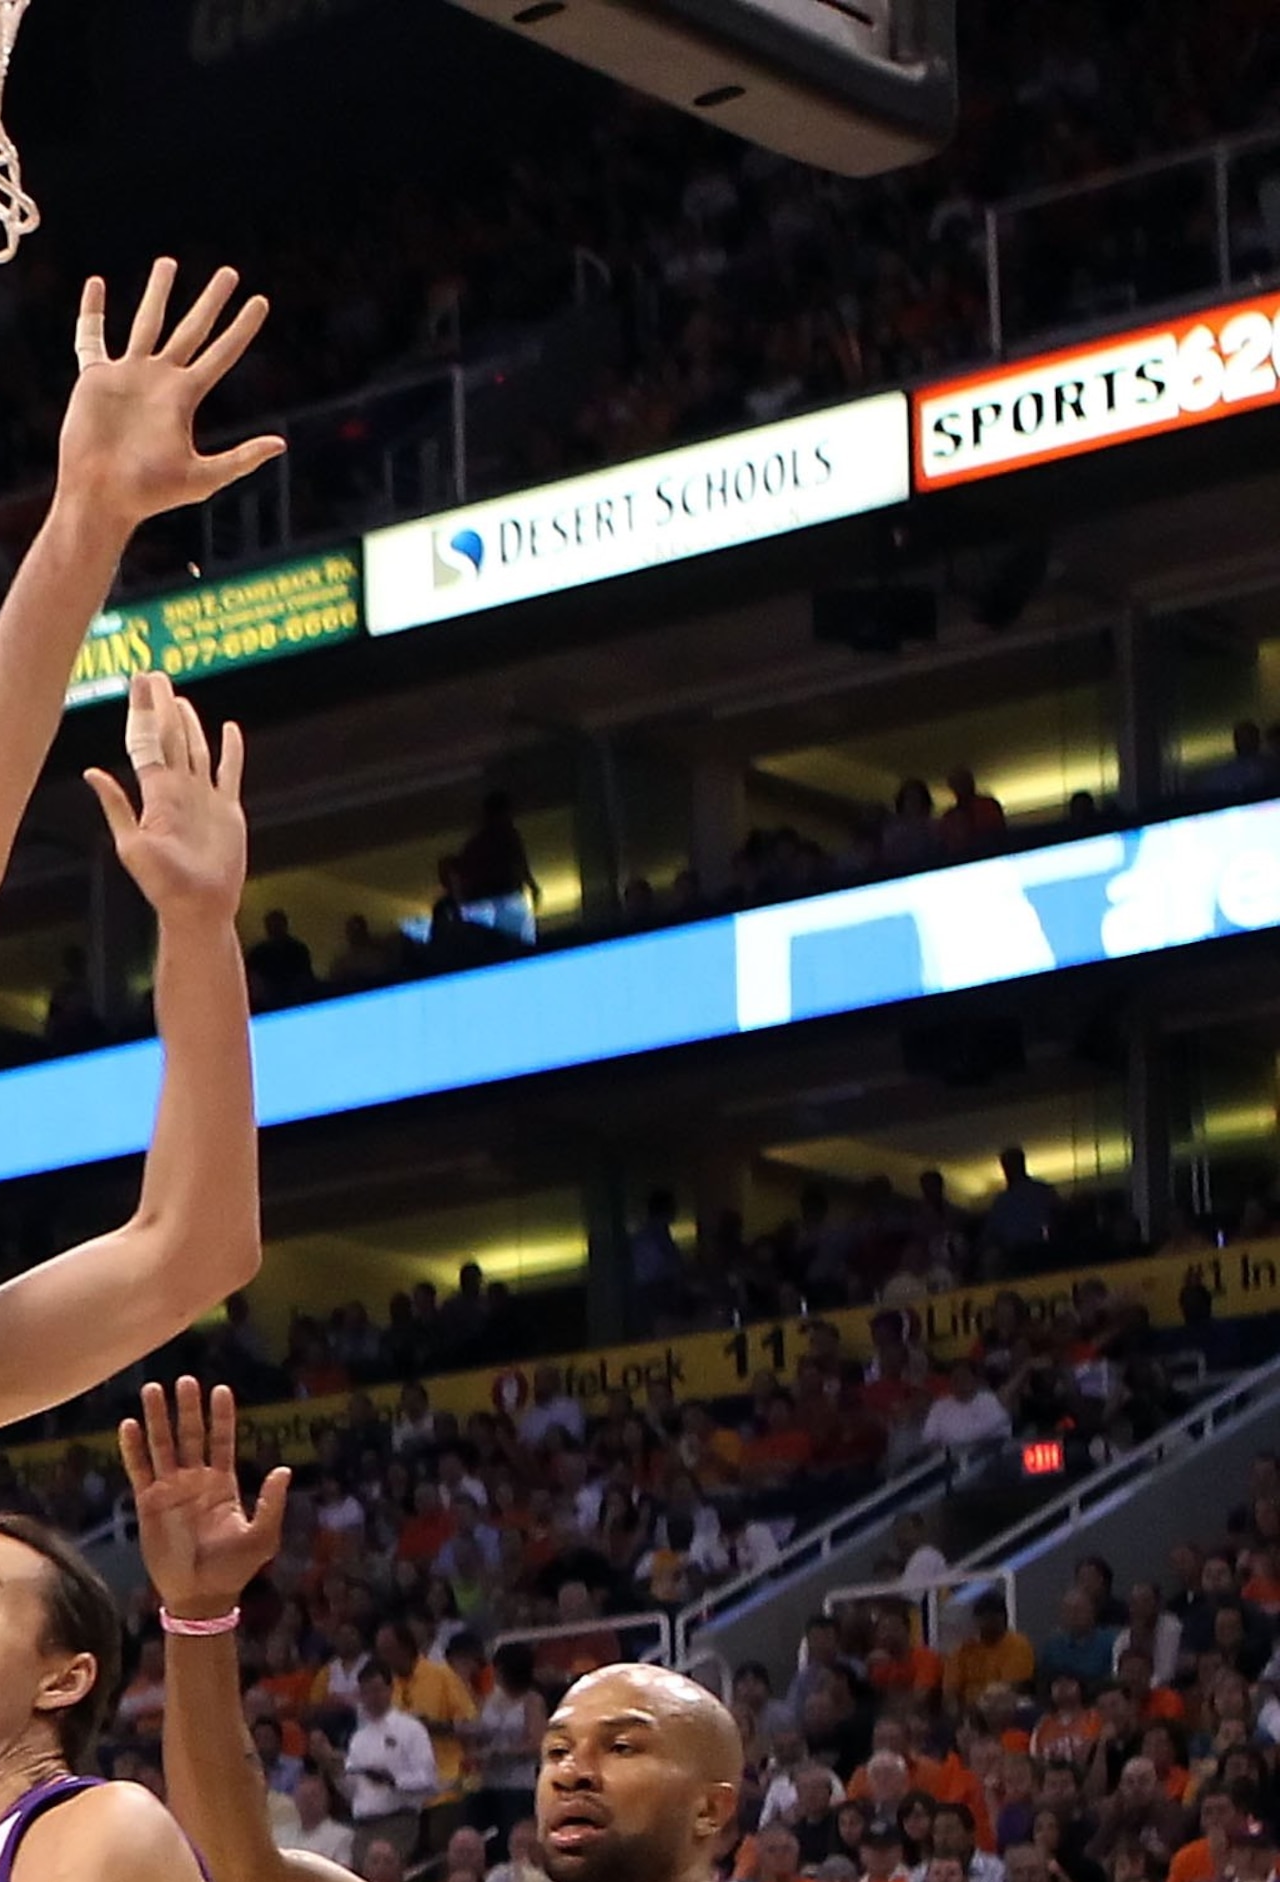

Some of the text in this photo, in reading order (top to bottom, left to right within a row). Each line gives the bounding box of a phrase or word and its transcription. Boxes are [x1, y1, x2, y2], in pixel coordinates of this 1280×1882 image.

[931, 357, 1166, 457] SPORTS
[499, 493, 636, 565] DESERT
[656, 440, 832, 526] SCHOOLS
